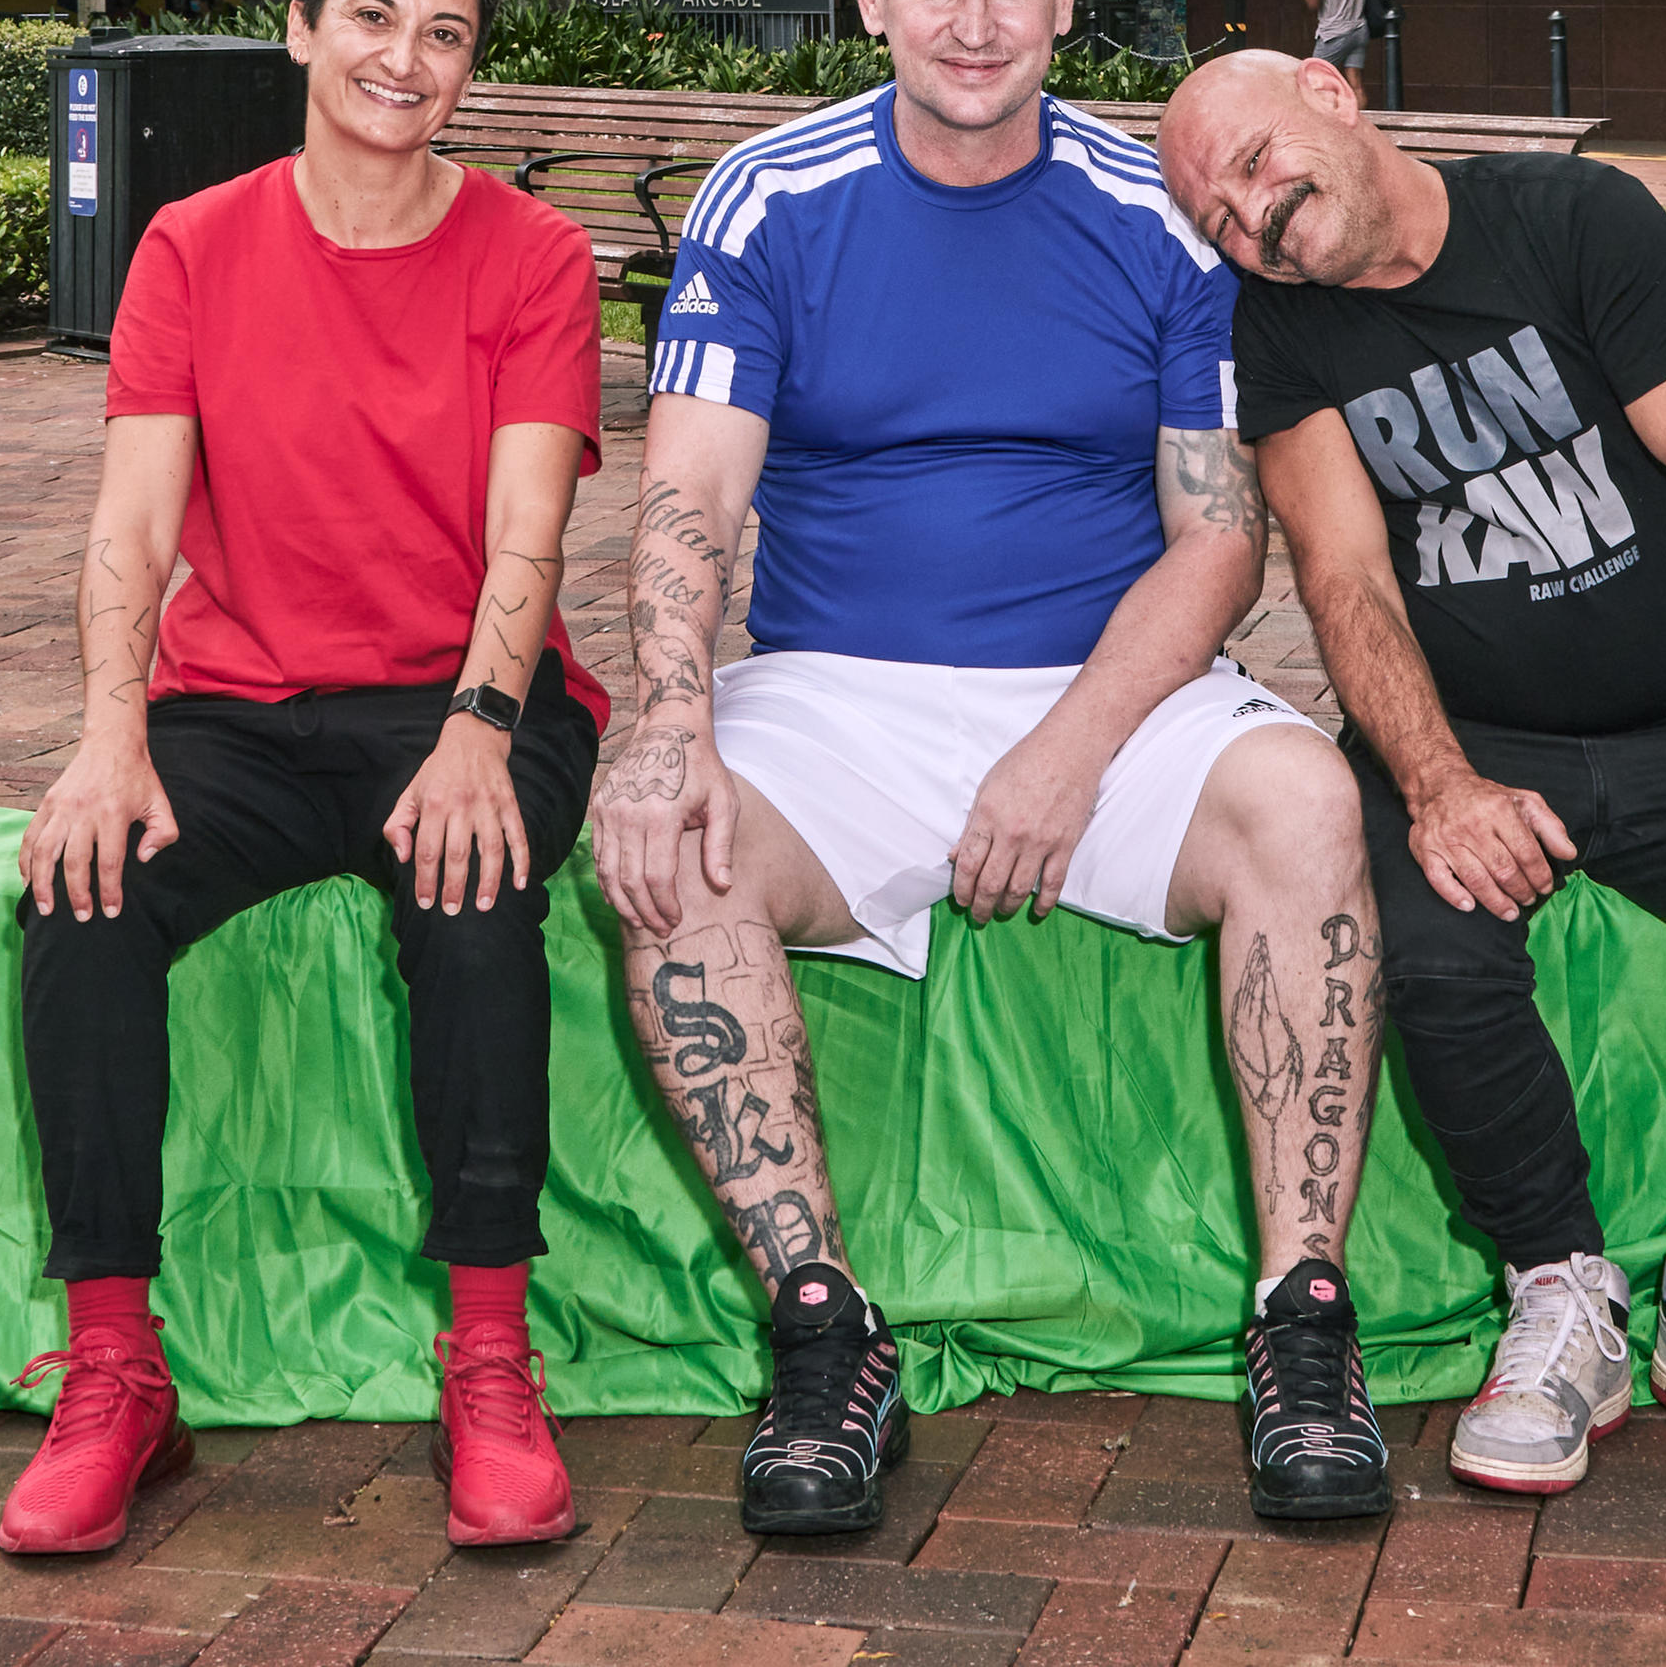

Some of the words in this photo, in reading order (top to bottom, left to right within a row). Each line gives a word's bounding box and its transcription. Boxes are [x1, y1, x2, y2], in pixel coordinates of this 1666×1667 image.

[669, 298, 720, 315] adidas
[1344, 324, 1583, 499] RUN
[1529, 572, 1564, 602] RAW
[1569, 545, 1641, 594] CHALLENGE
[1298, 913, 1360, 1263] DRAGONS
